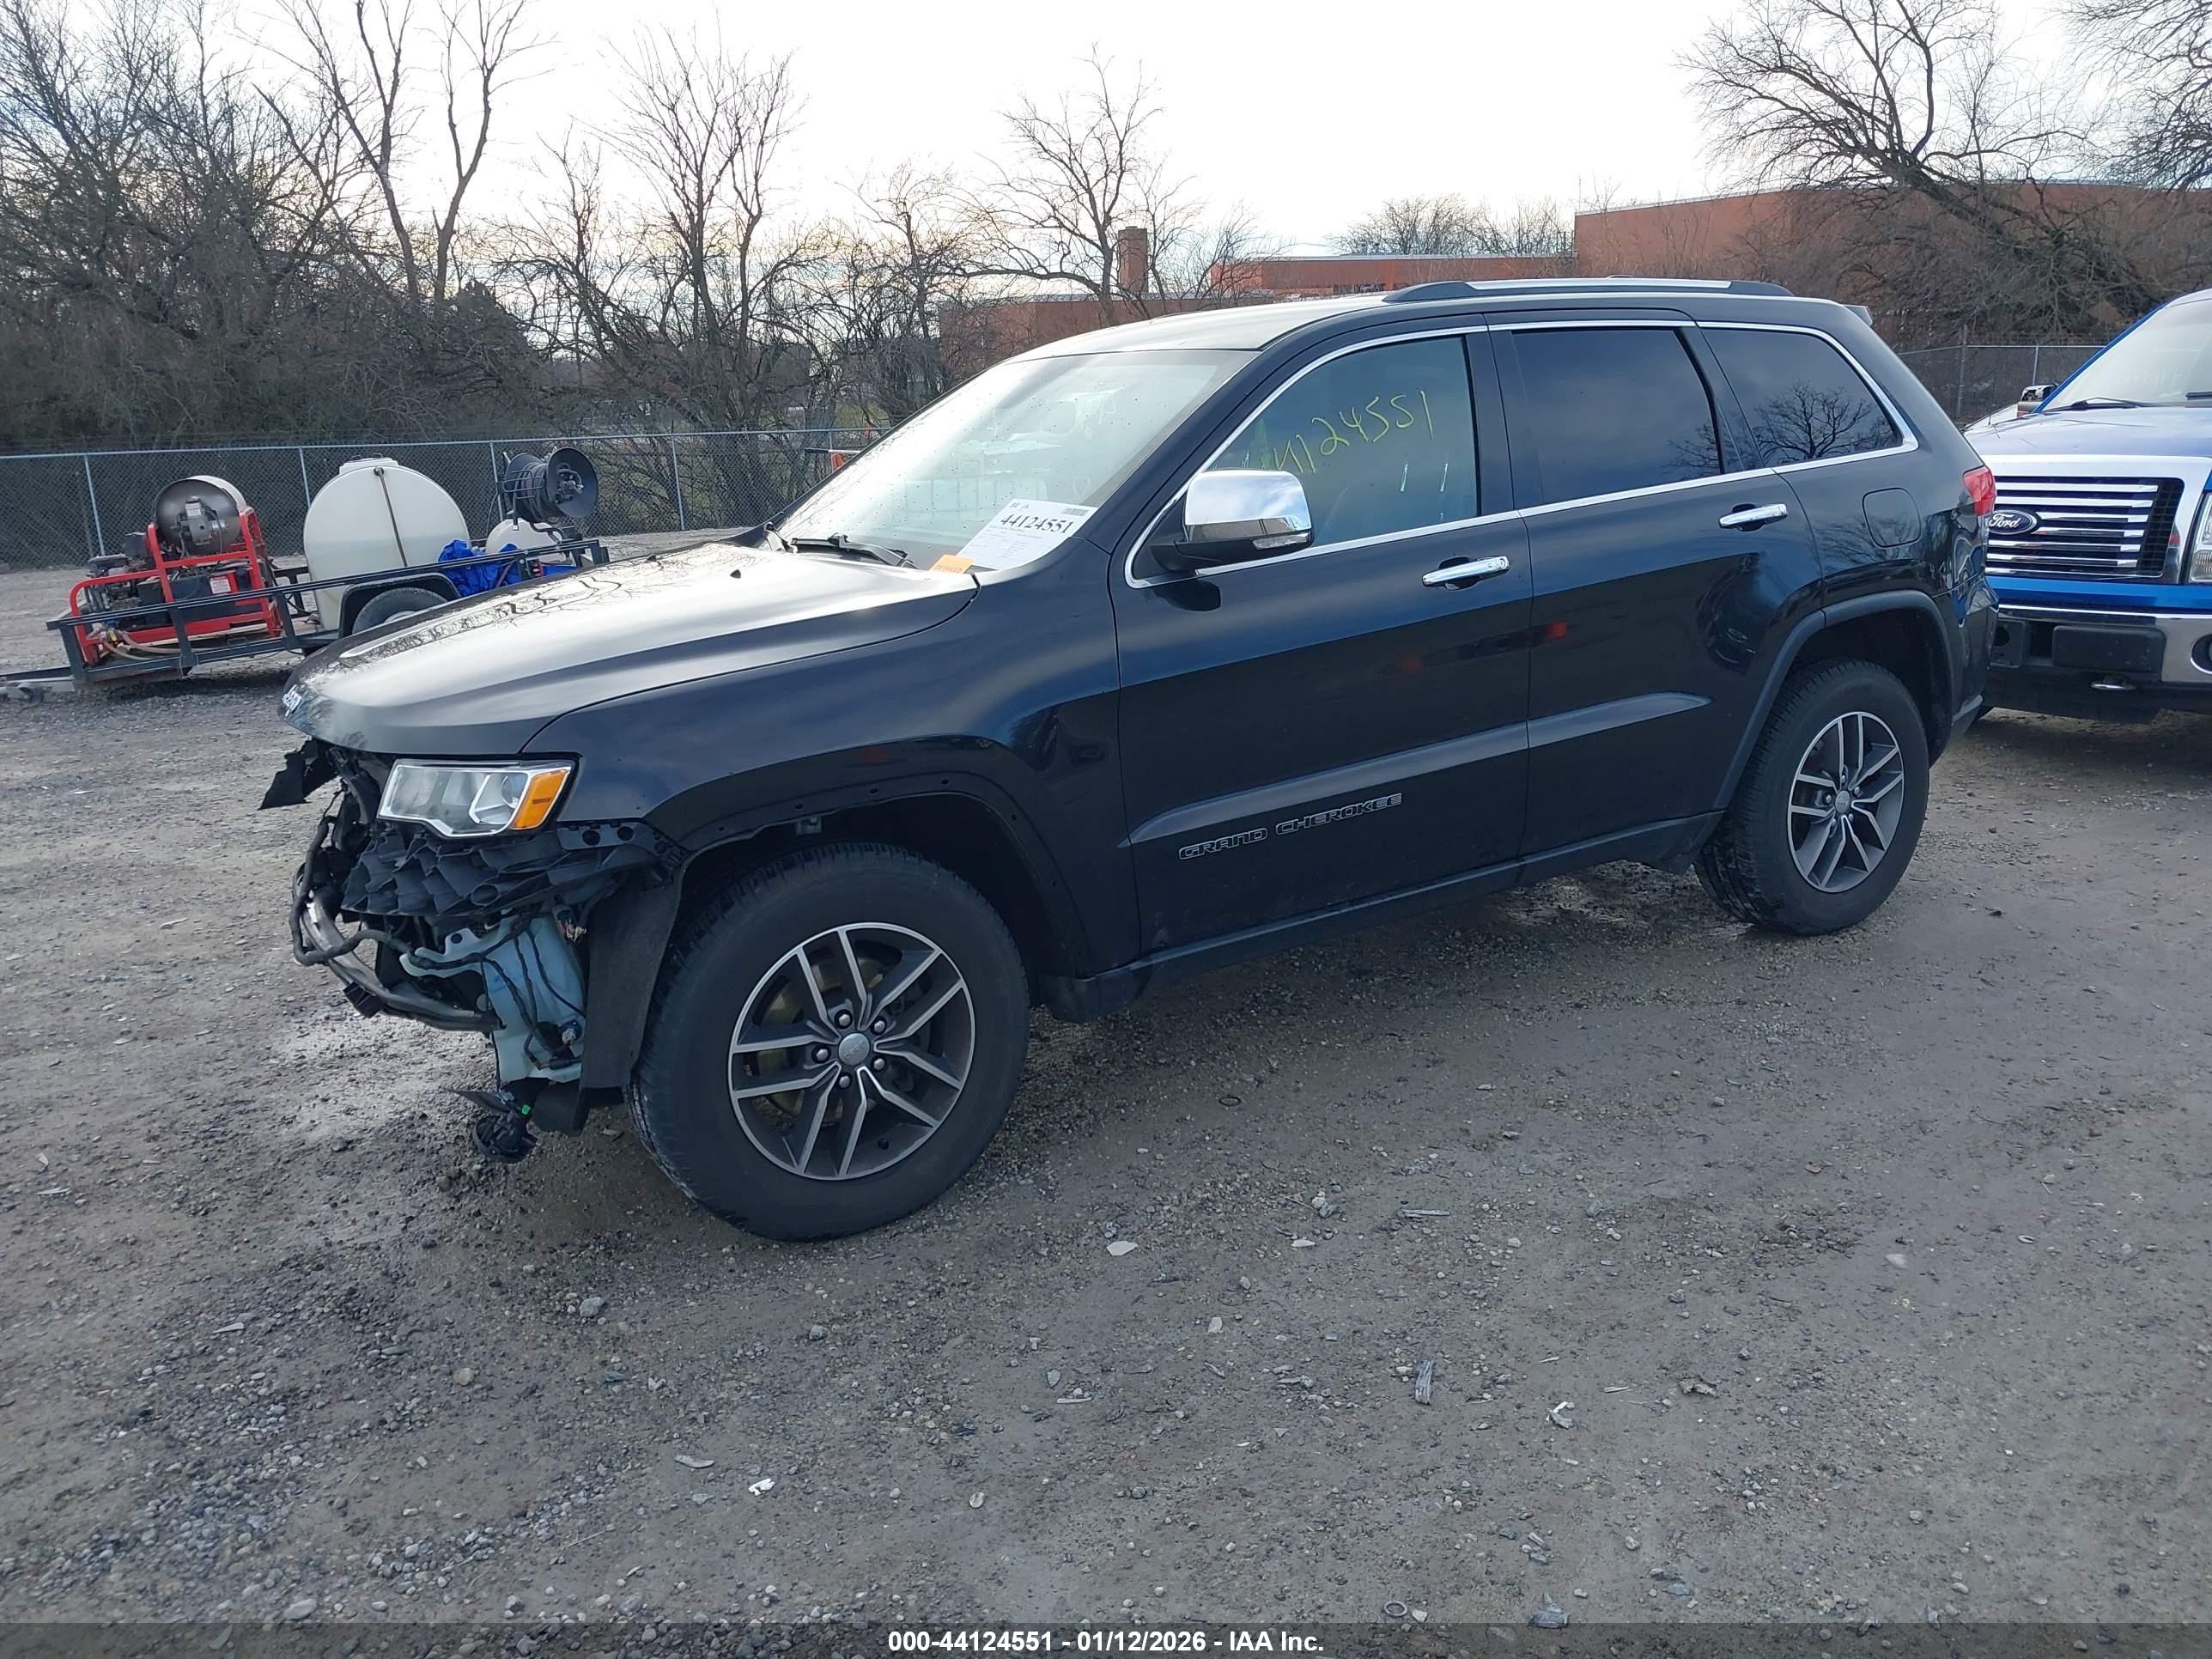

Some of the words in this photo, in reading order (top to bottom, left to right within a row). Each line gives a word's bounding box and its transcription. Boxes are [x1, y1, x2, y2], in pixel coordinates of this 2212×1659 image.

[1261, 390, 1434, 473] 4124551
[1000, 514, 1075, 533] 44124551
[1989, 513, 2021, 528] Ford
[1179, 828, 1268, 860] GRAND
[1276, 793, 1402, 836] CHEROKEE
